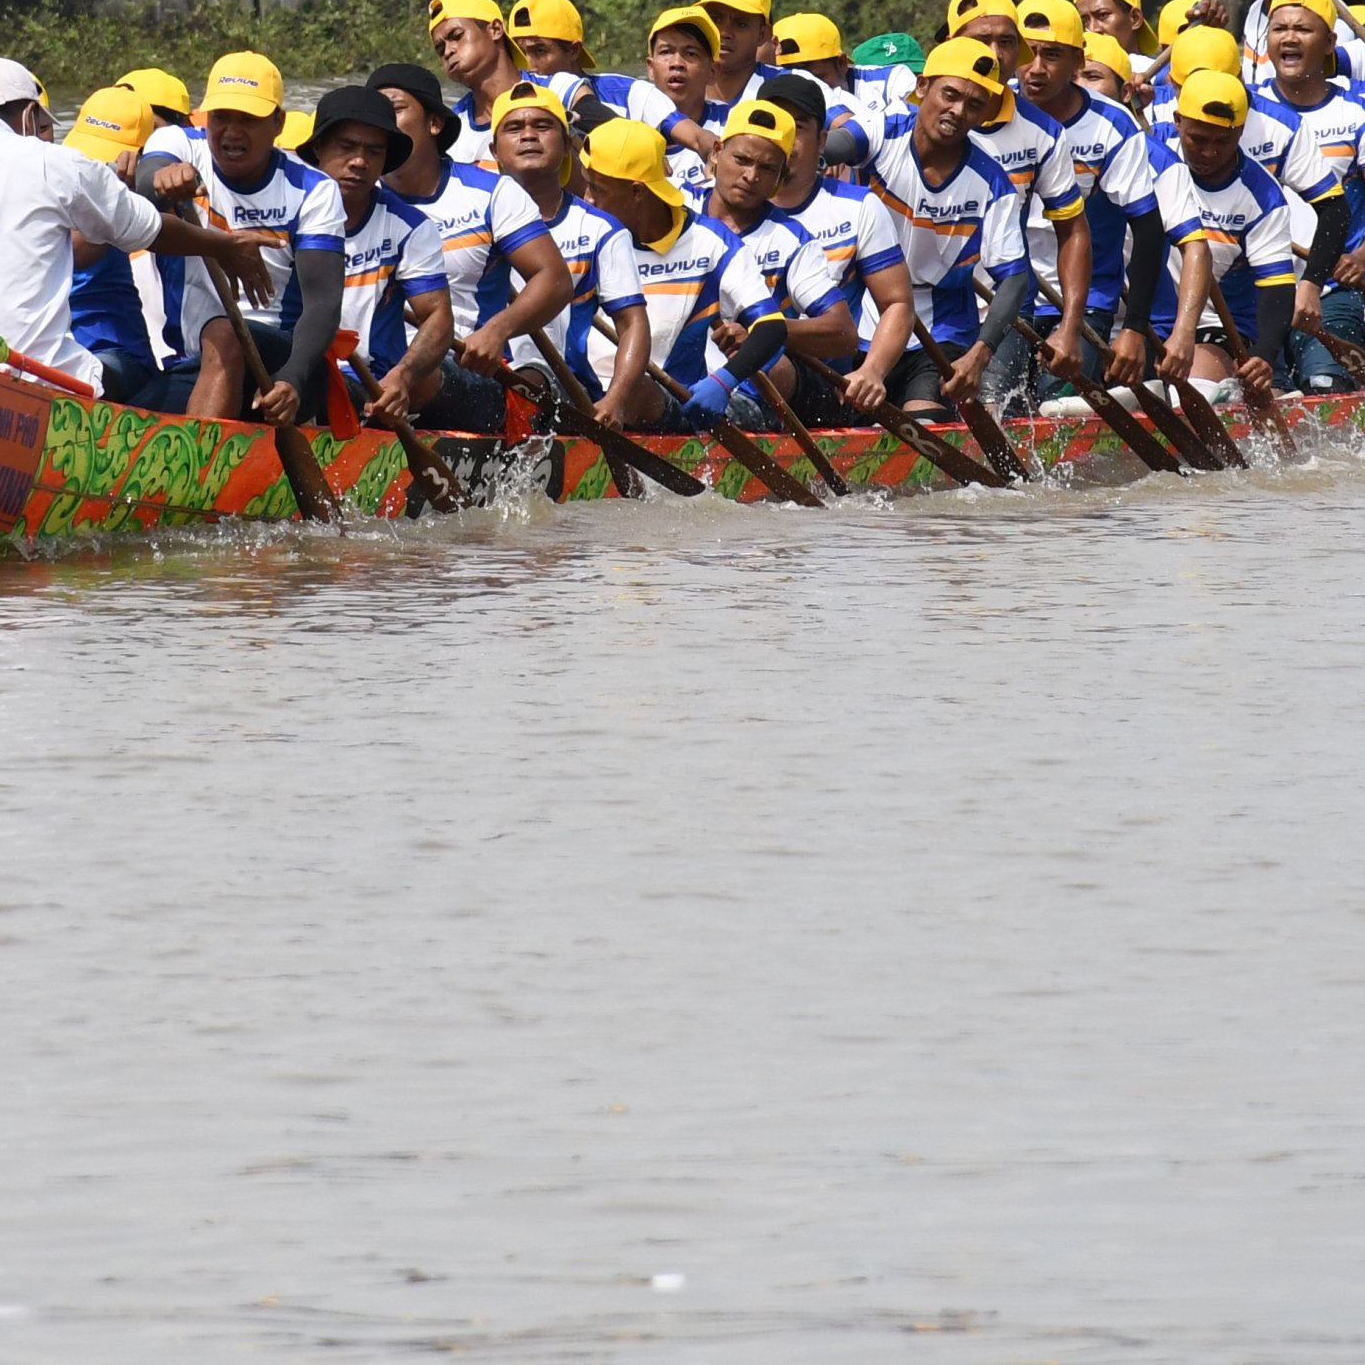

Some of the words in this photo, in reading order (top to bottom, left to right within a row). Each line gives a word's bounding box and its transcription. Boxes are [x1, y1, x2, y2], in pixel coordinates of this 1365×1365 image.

[218, 76, 259, 87] Revive
[84, 116, 122, 132] Revive
[234, 206, 287, 223] Reviv
[638, 256, 710, 278] Revive
[13, 406, 42, 449] PHỐ
